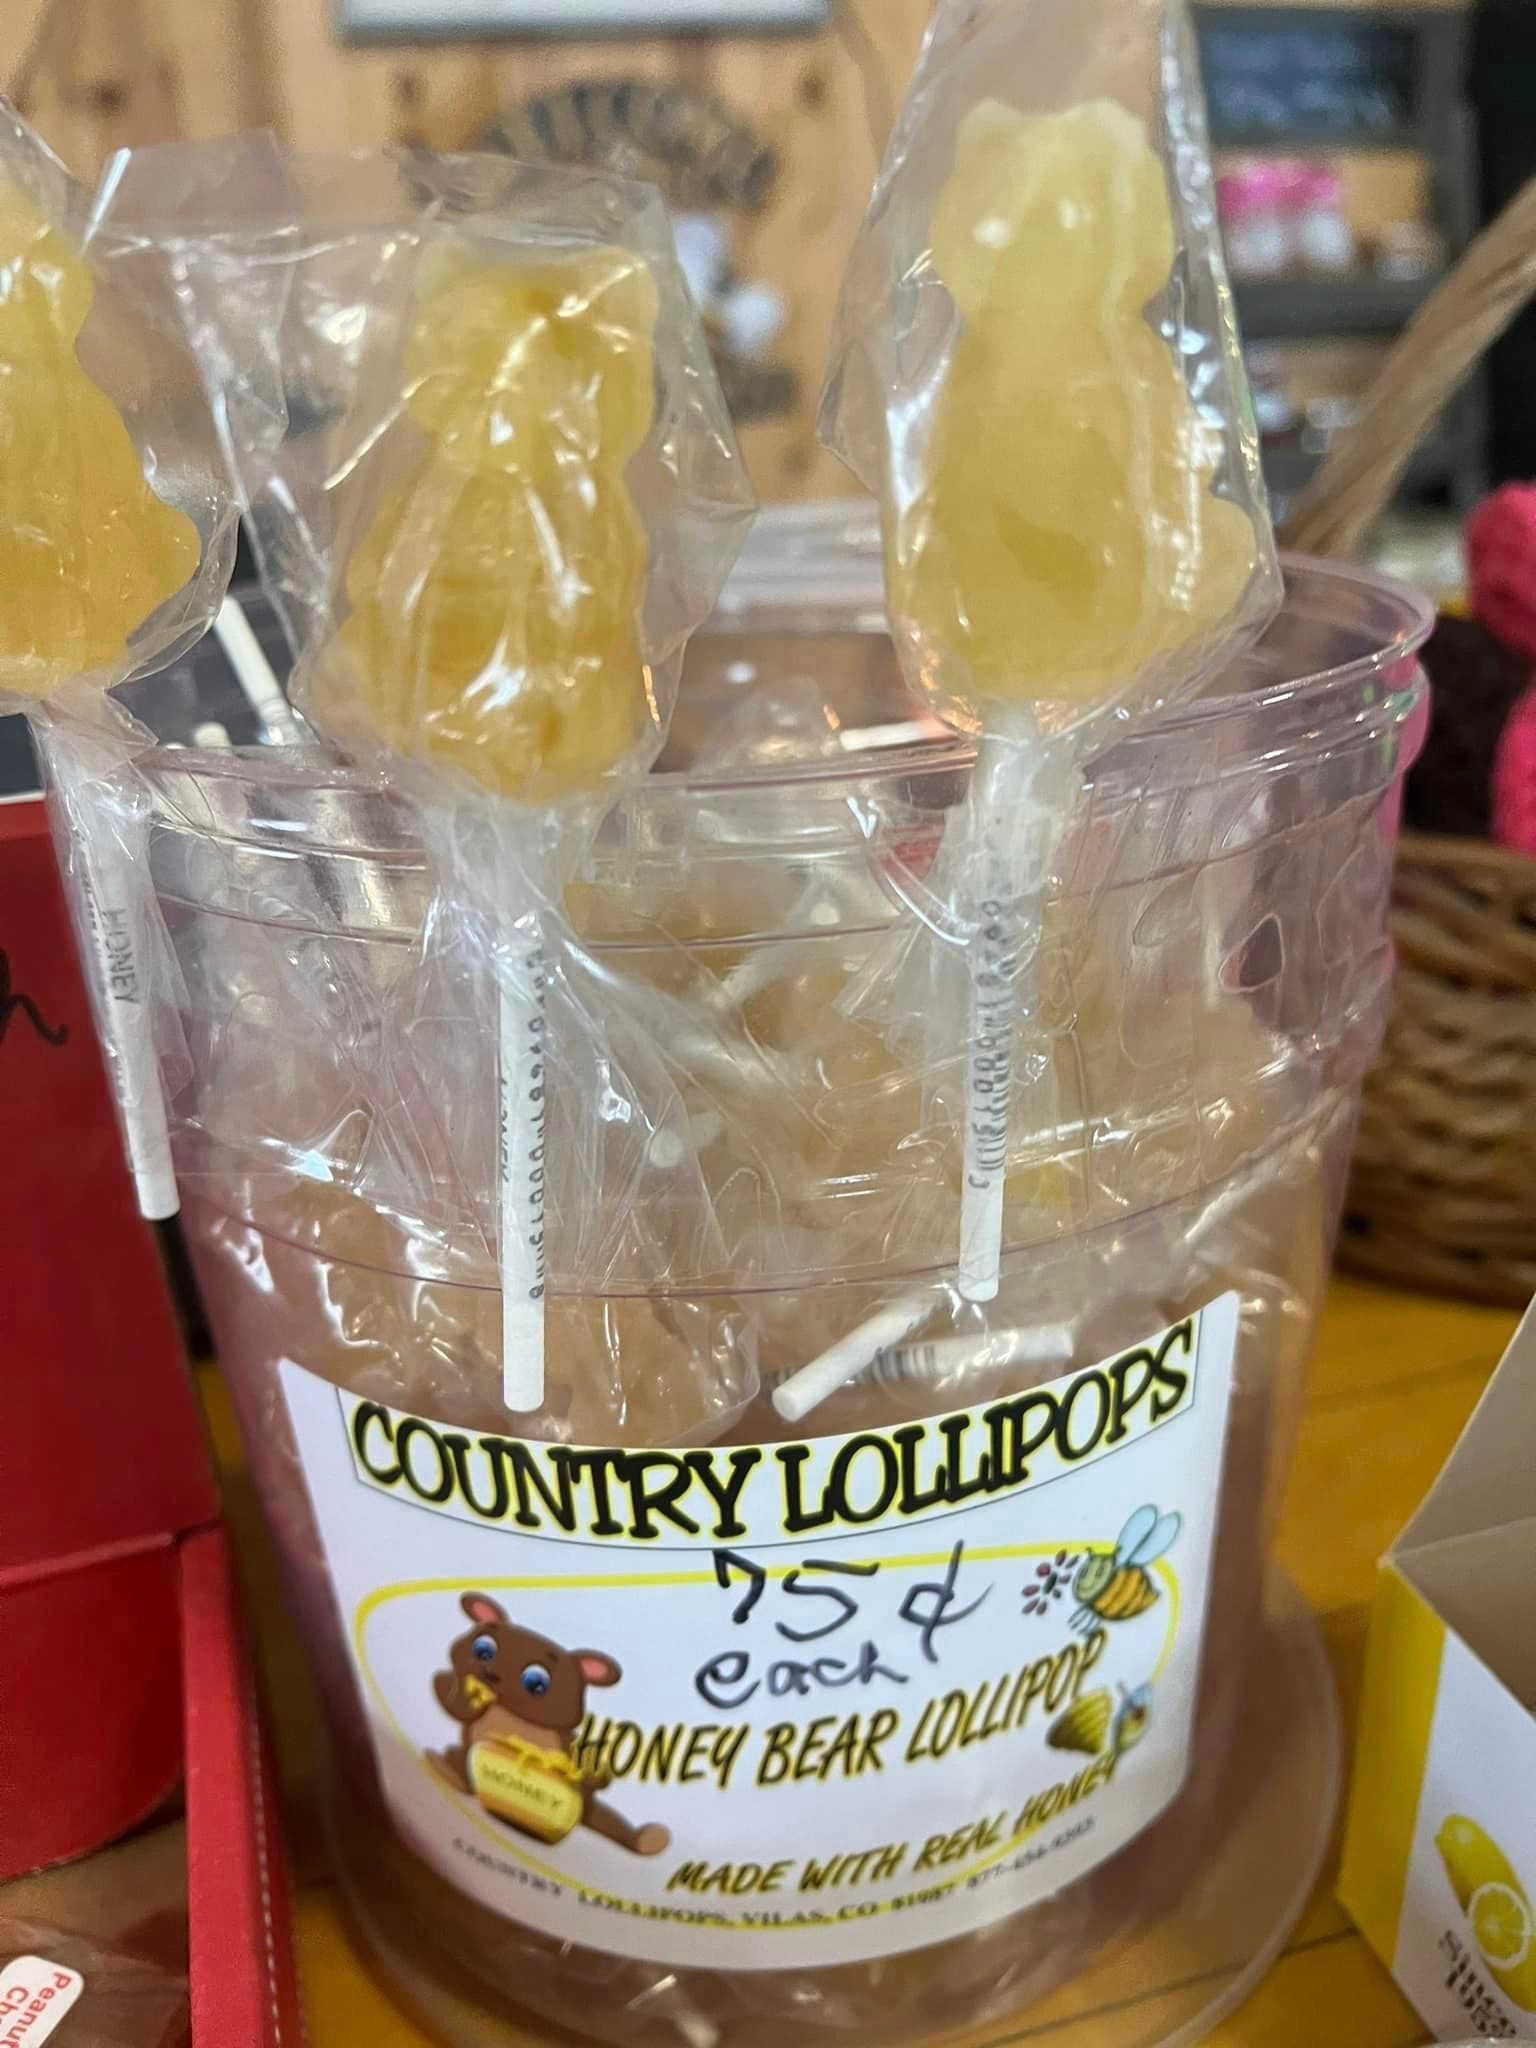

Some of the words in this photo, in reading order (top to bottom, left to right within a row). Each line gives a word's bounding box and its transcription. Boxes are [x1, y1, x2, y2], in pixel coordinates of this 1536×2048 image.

[352, 1400, 762, 1538] COUNTRY
[778, 1318, 1195, 1534] LOLLIPOPS
[573, 1711, 750, 1785] HONEY
[755, 1708, 900, 1787] BEAR
[904, 1629, 1108, 1763] LOLLIPOP
[694, 1640, 908, 1709] each
[666, 1860, 797, 1895] MADE
[799, 1842, 910, 1893] WITH
[912, 1809, 1009, 1874] REAL
[1012, 1742, 1122, 1838] HONEY
